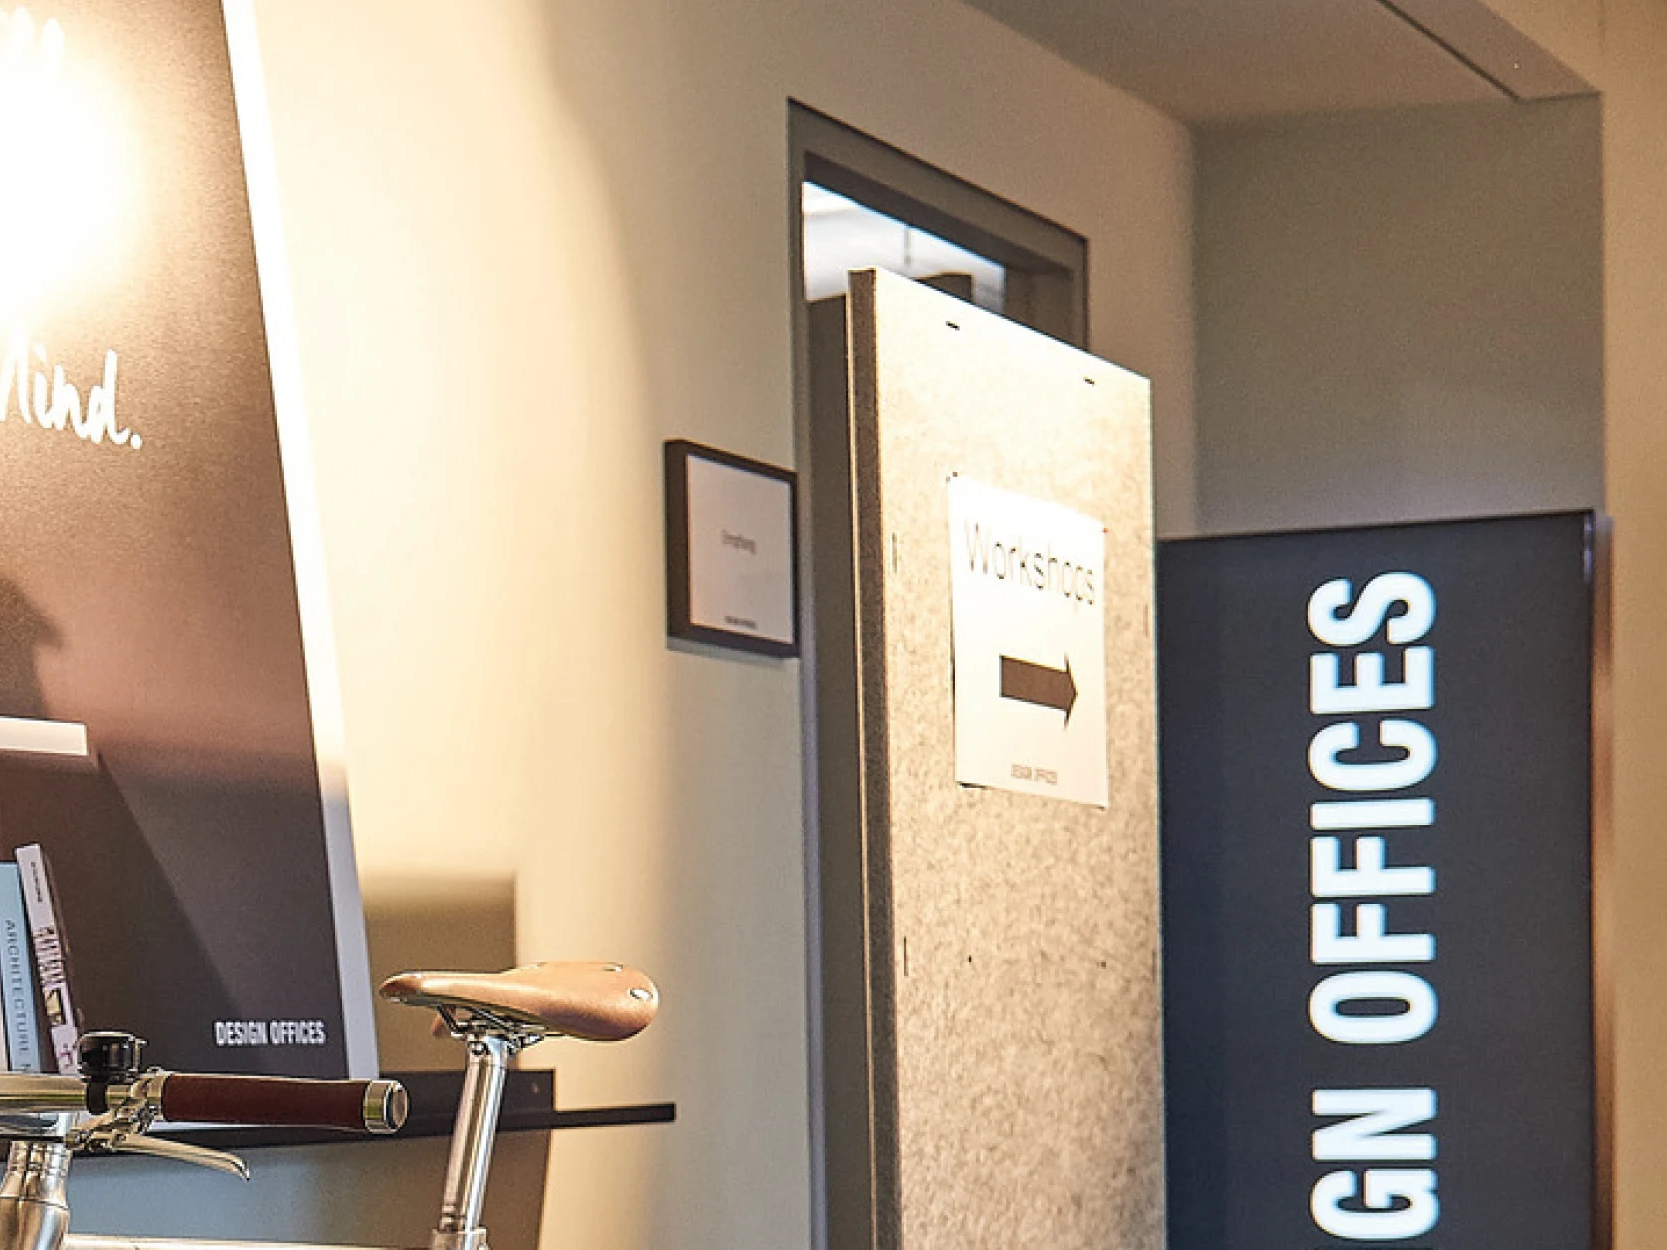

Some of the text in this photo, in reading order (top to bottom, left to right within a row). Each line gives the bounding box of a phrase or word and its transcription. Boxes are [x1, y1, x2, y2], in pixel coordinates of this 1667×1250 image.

[1307, 570, 1438, 1044] OFFICES
[5, 919, 30, 1056] ARCHITECTURE
[215, 1020, 327, 1045] DESIGN OFFICES
